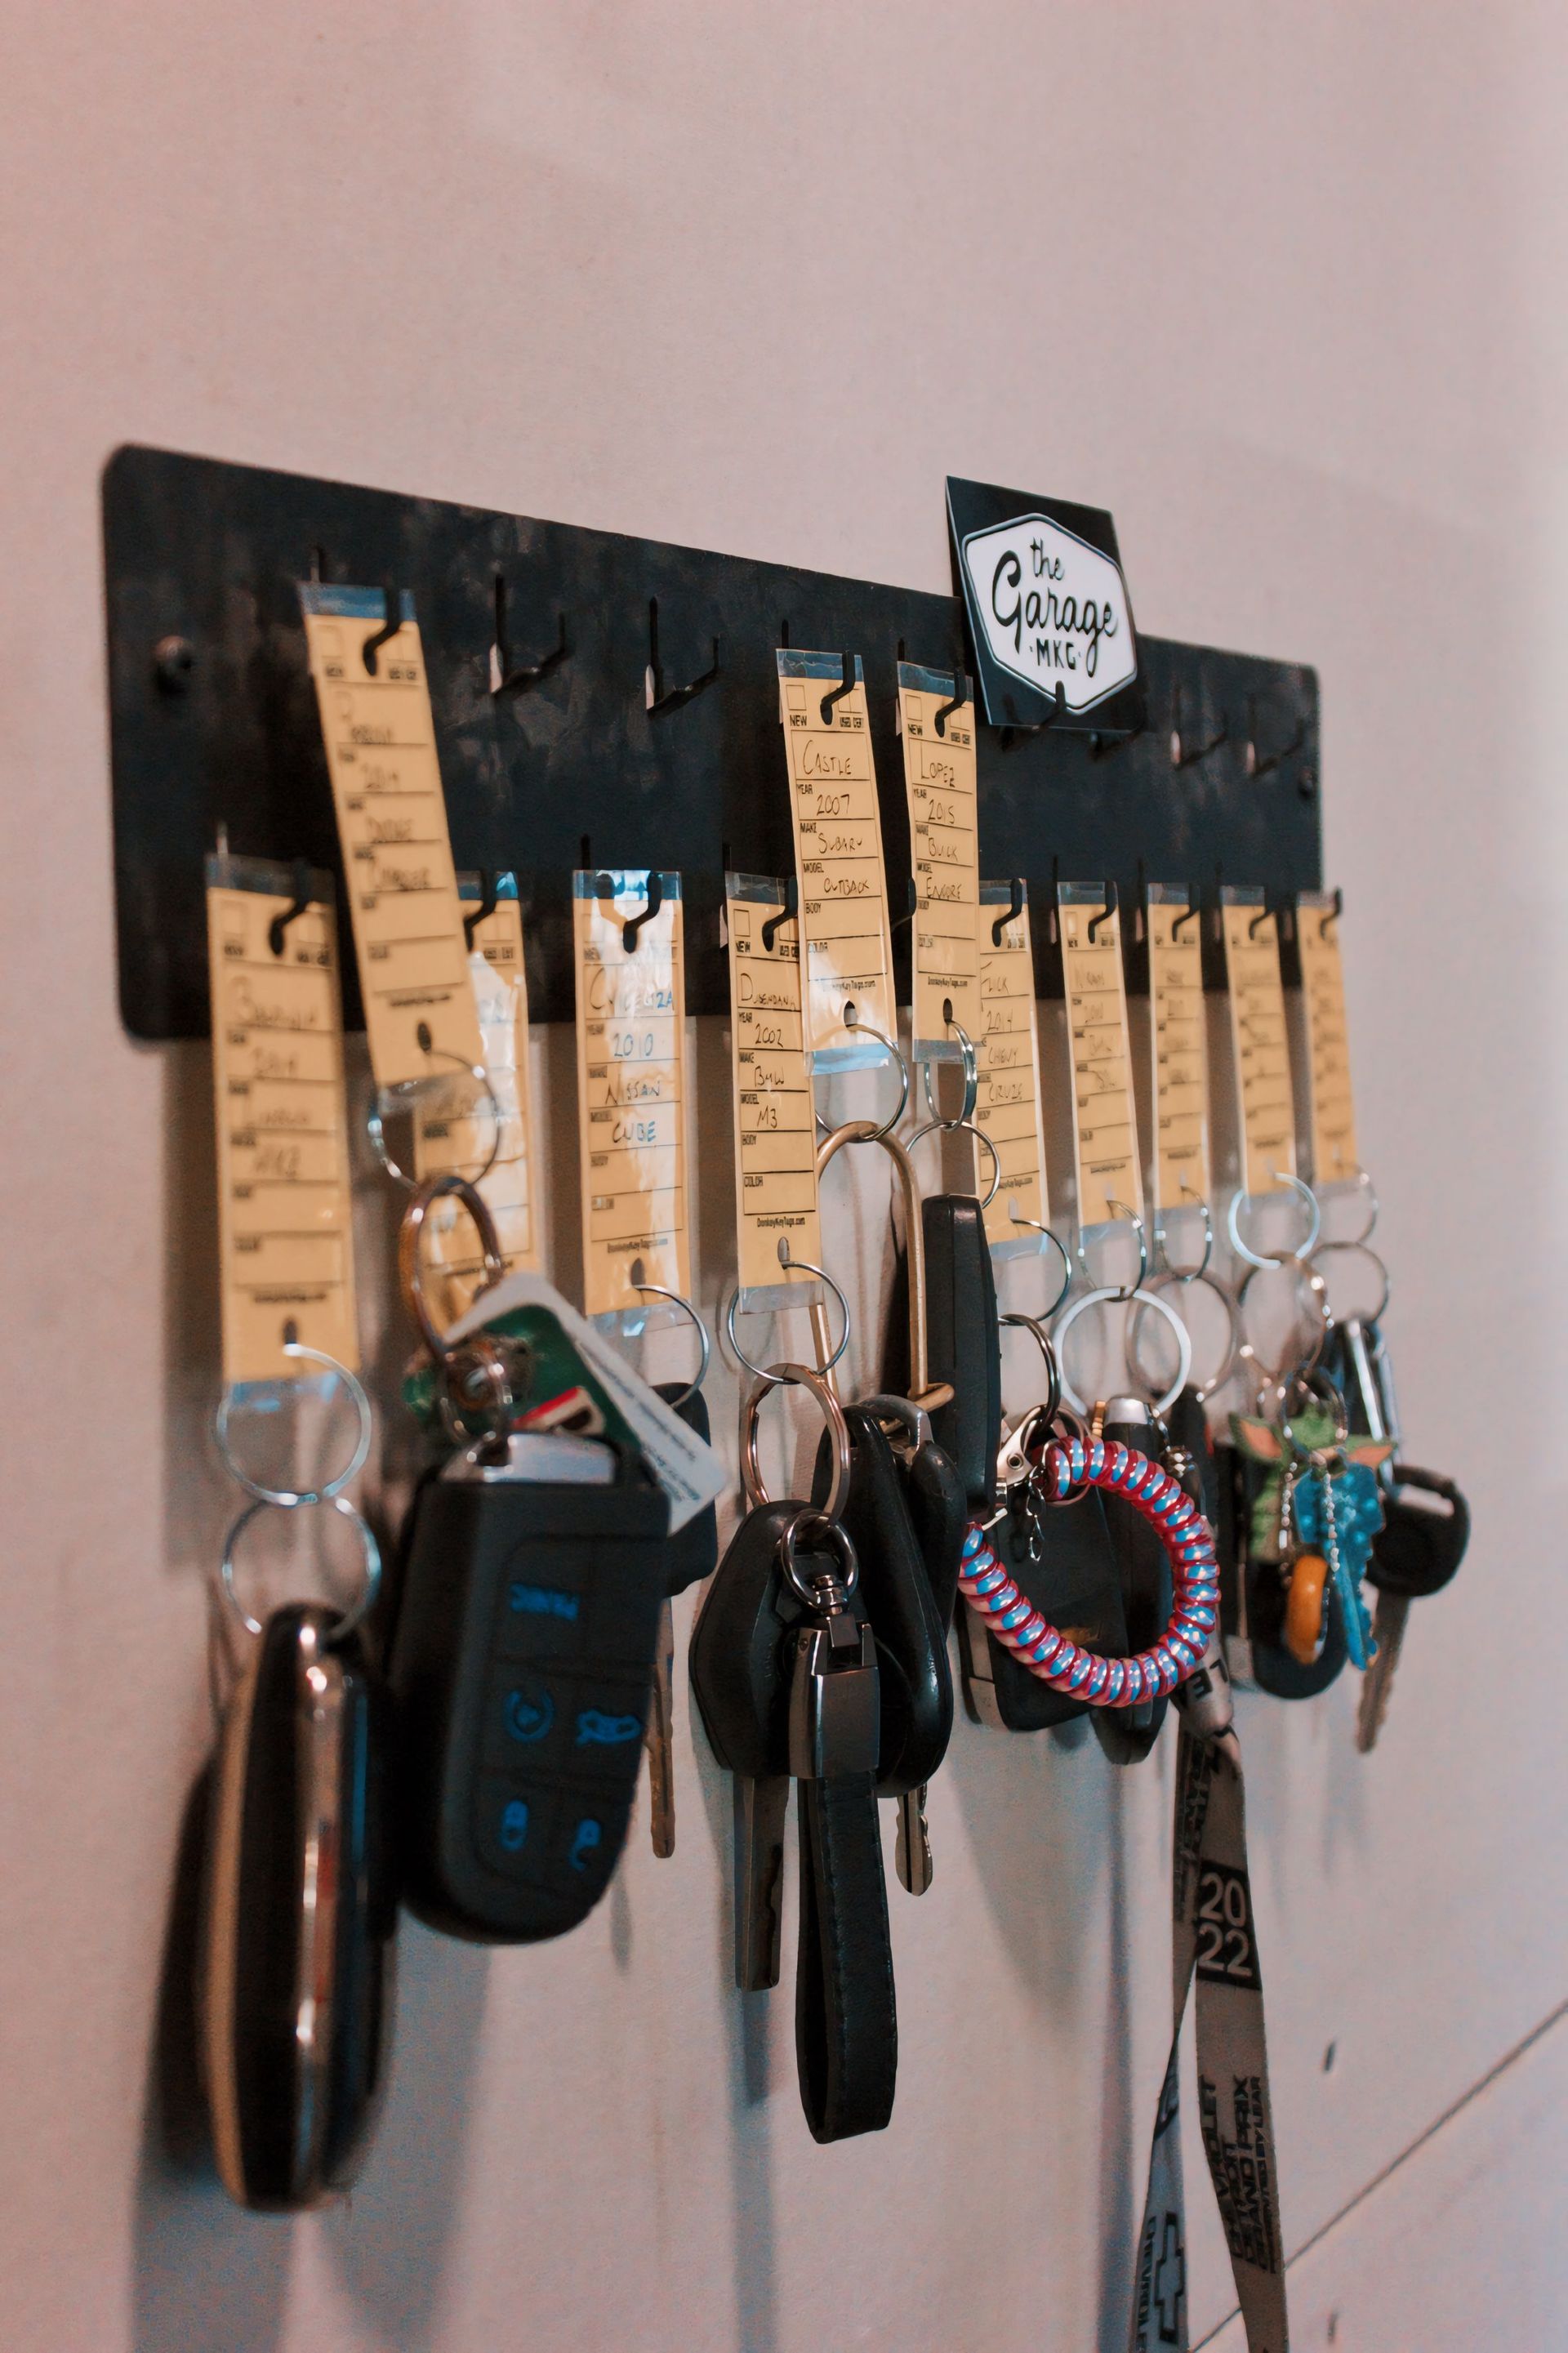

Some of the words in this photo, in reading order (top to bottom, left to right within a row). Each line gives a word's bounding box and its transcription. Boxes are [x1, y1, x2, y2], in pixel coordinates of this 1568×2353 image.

[1030, 537, 1064, 581] the
[992, 550, 1118, 678] Garage
[790, 715, 807, 726] NEW
[803, 739, 852, 775] CASTLE
[920, 740, 956, 787] LOPEZ
[797, 784, 813, 795] YEAR
[817, 794, 850, 816] 2007
[929, 799, 955, 824] 2015
[800, 822, 817, 833] MAKE
[803, 862, 824, 873] MODEL
[805, 902, 822, 914] BODY
[613, 1033, 653, 1057] 2010
[755, 1023, 784, 1048] 2002
[754, 1065, 785, 1088] BMW
[605, 1073, 661, 1105] NISSAN
[756, 1105, 777, 1129] M3
[612, 1121, 657, 1143] CUBE
[1199, 1871, 1246, 1928] 20
[1198, 1922, 1253, 1977] 22
